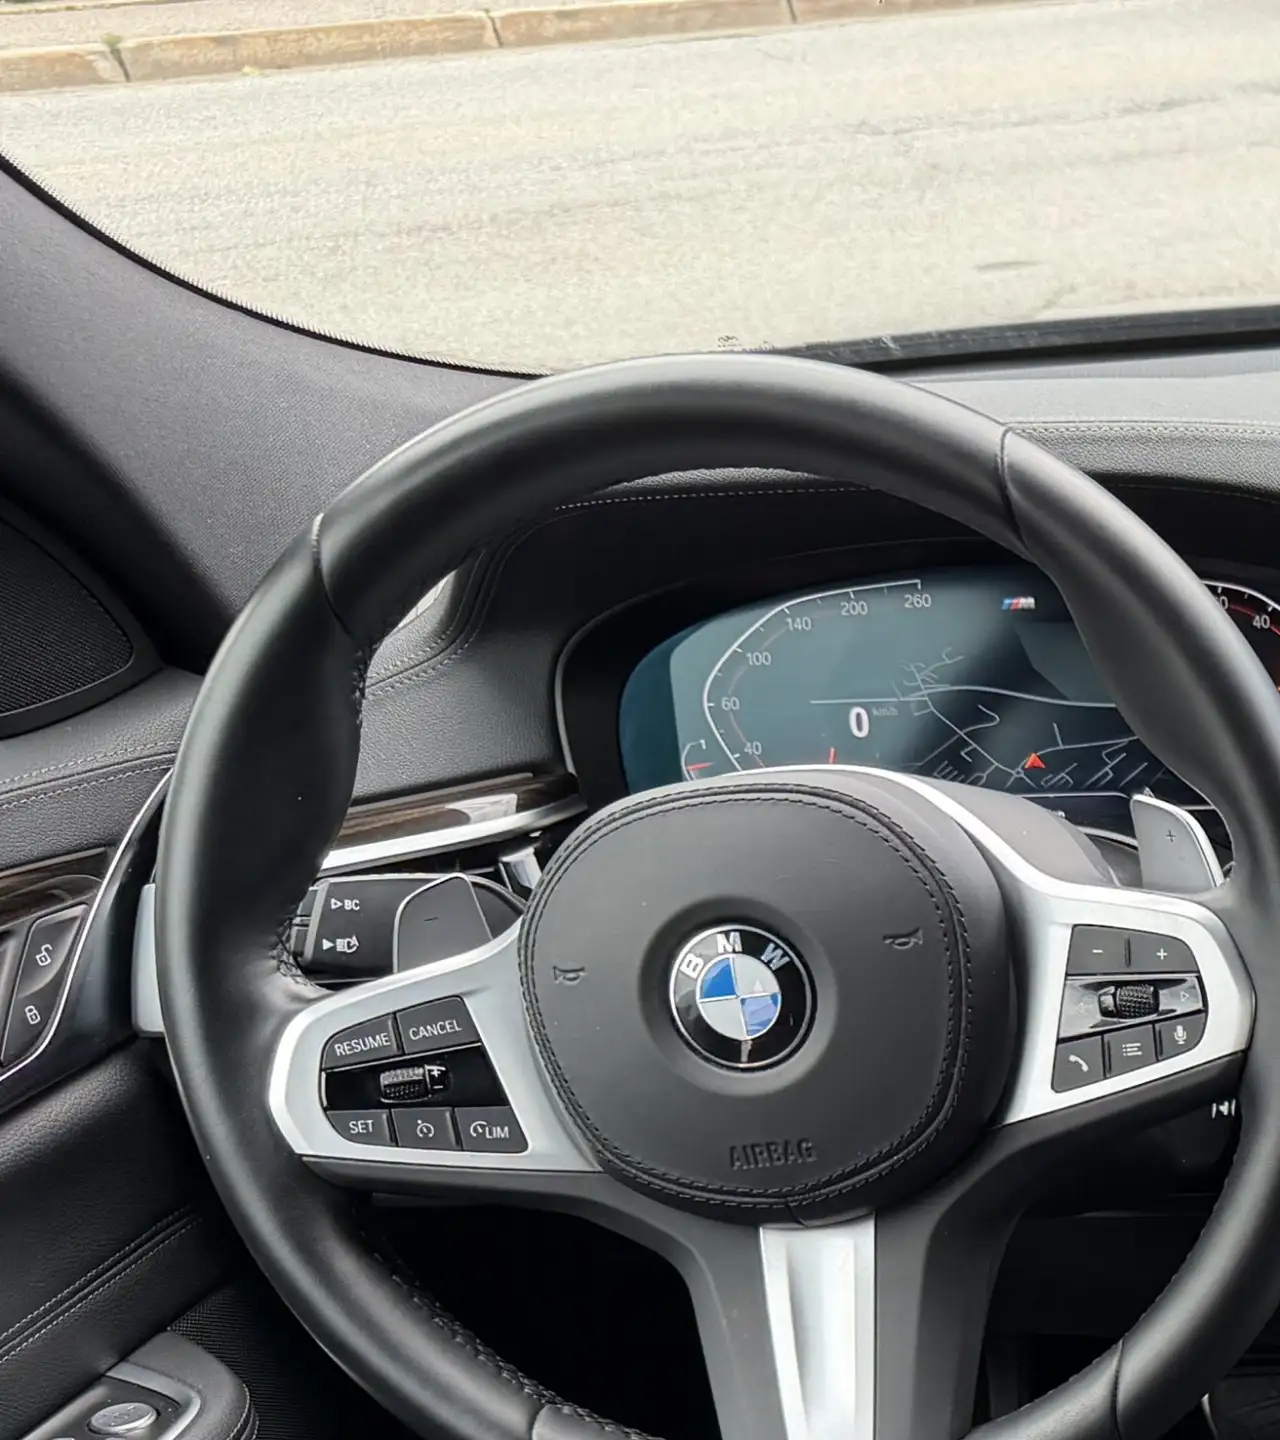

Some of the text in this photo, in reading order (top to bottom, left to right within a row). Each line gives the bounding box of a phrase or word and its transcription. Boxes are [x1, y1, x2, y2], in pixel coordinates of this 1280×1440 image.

[840, 600, 869, 616] 200
[904, 593, 932, 609] 260
[786, 616, 812, 632] 140
[1252, 614, 1271, 629] 40
[747, 652, 772, 667] 100
[721, 696, 741, 711] 60
[872, 706, 899, 717] km/h
[849, 706, 870, 738] 0
[743, 741, 763, 756] 40
[344, 899, 360, 911] BC
[679, 931, 790, 980] BMW
[408, 1019, 463, 1040] CANCEL
[334, 1032, 392, 1057] RESUME
[349, 1119, 374, 1134] SET
[485, 1127, 509, 1139] LIM
[729, 1138, 817, 1170] AIRBAG
